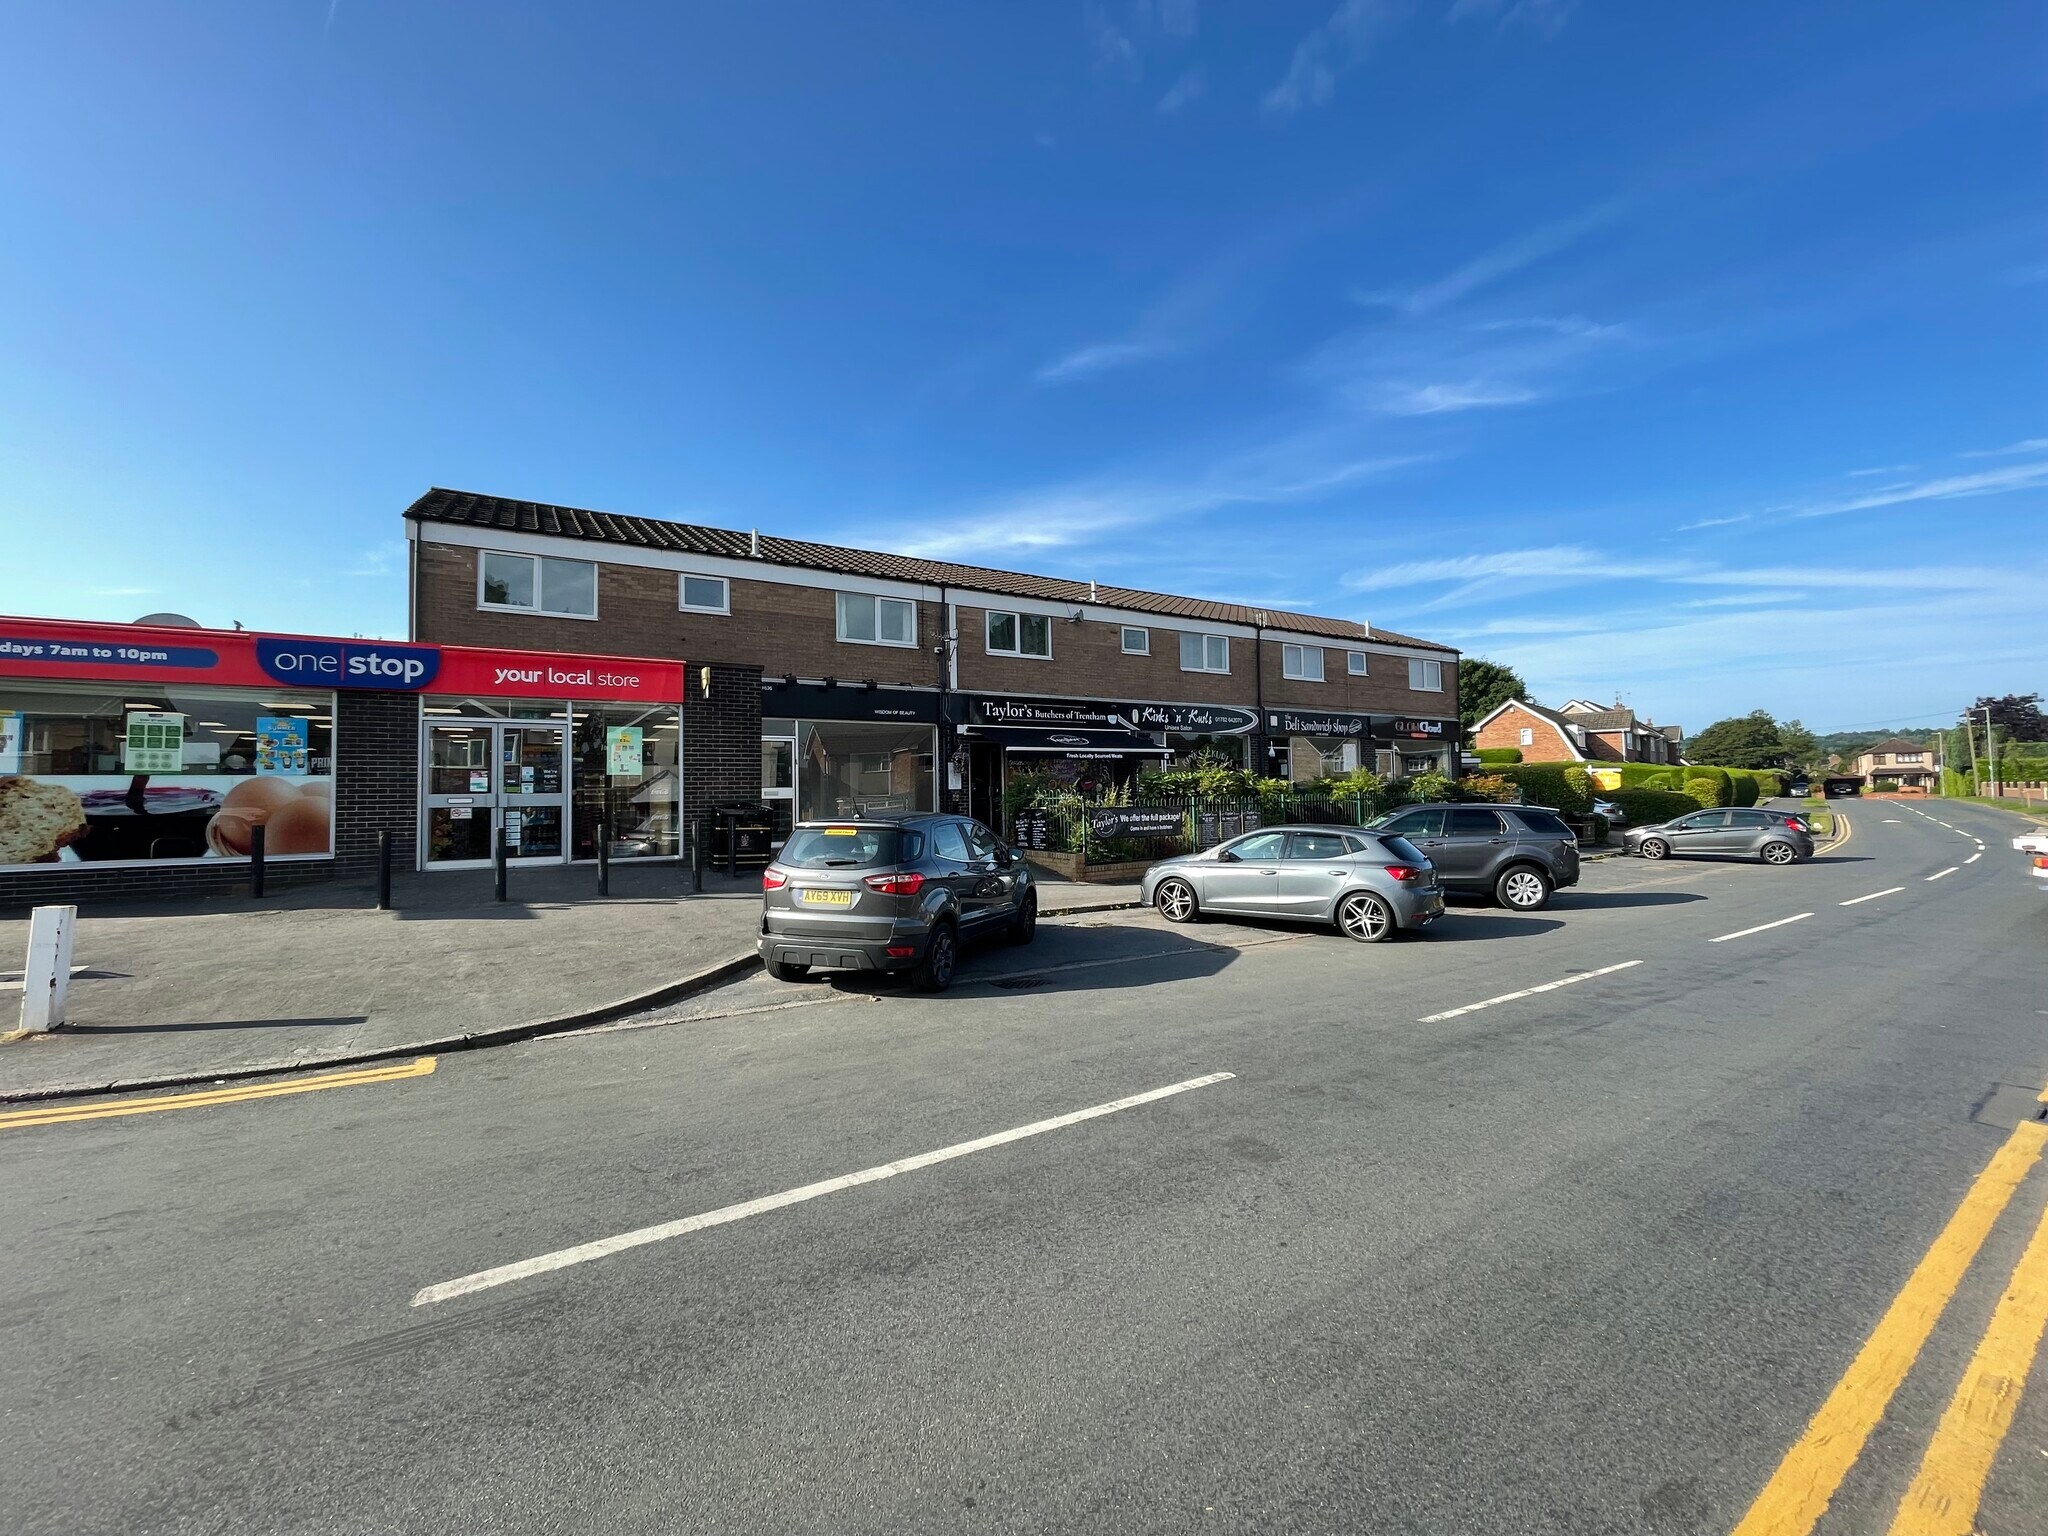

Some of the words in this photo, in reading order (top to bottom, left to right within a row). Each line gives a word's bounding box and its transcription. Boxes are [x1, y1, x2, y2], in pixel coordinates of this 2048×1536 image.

[0, 642, 43, 656] days
[50, 645, 88, 656] 7am
[93, 648, 112, 657] to
[117, 648, 168, 661] 10pm
[275, 653, 338, 673] one
[347, 653, 424, 683] stop
[494, 667, 542, 685] your
[548, 668, 592, 686] local
[597, 674, 640, 688] store
[983, 701, 1033, 721] Taylor's
[1035, 709, 1065, 719] Butchers
[1066, 710, 1074, 719] of
[1074, 711, 1107, 721] Trentham
[1142, 706, 1169, 724] Kinks
[1188, 708, 1213, 725] Kurls
[1285, 716, 1300, 731] Deli
[804, 890, 828, 901] AY69
[830, 892, 850, 902] XVH
